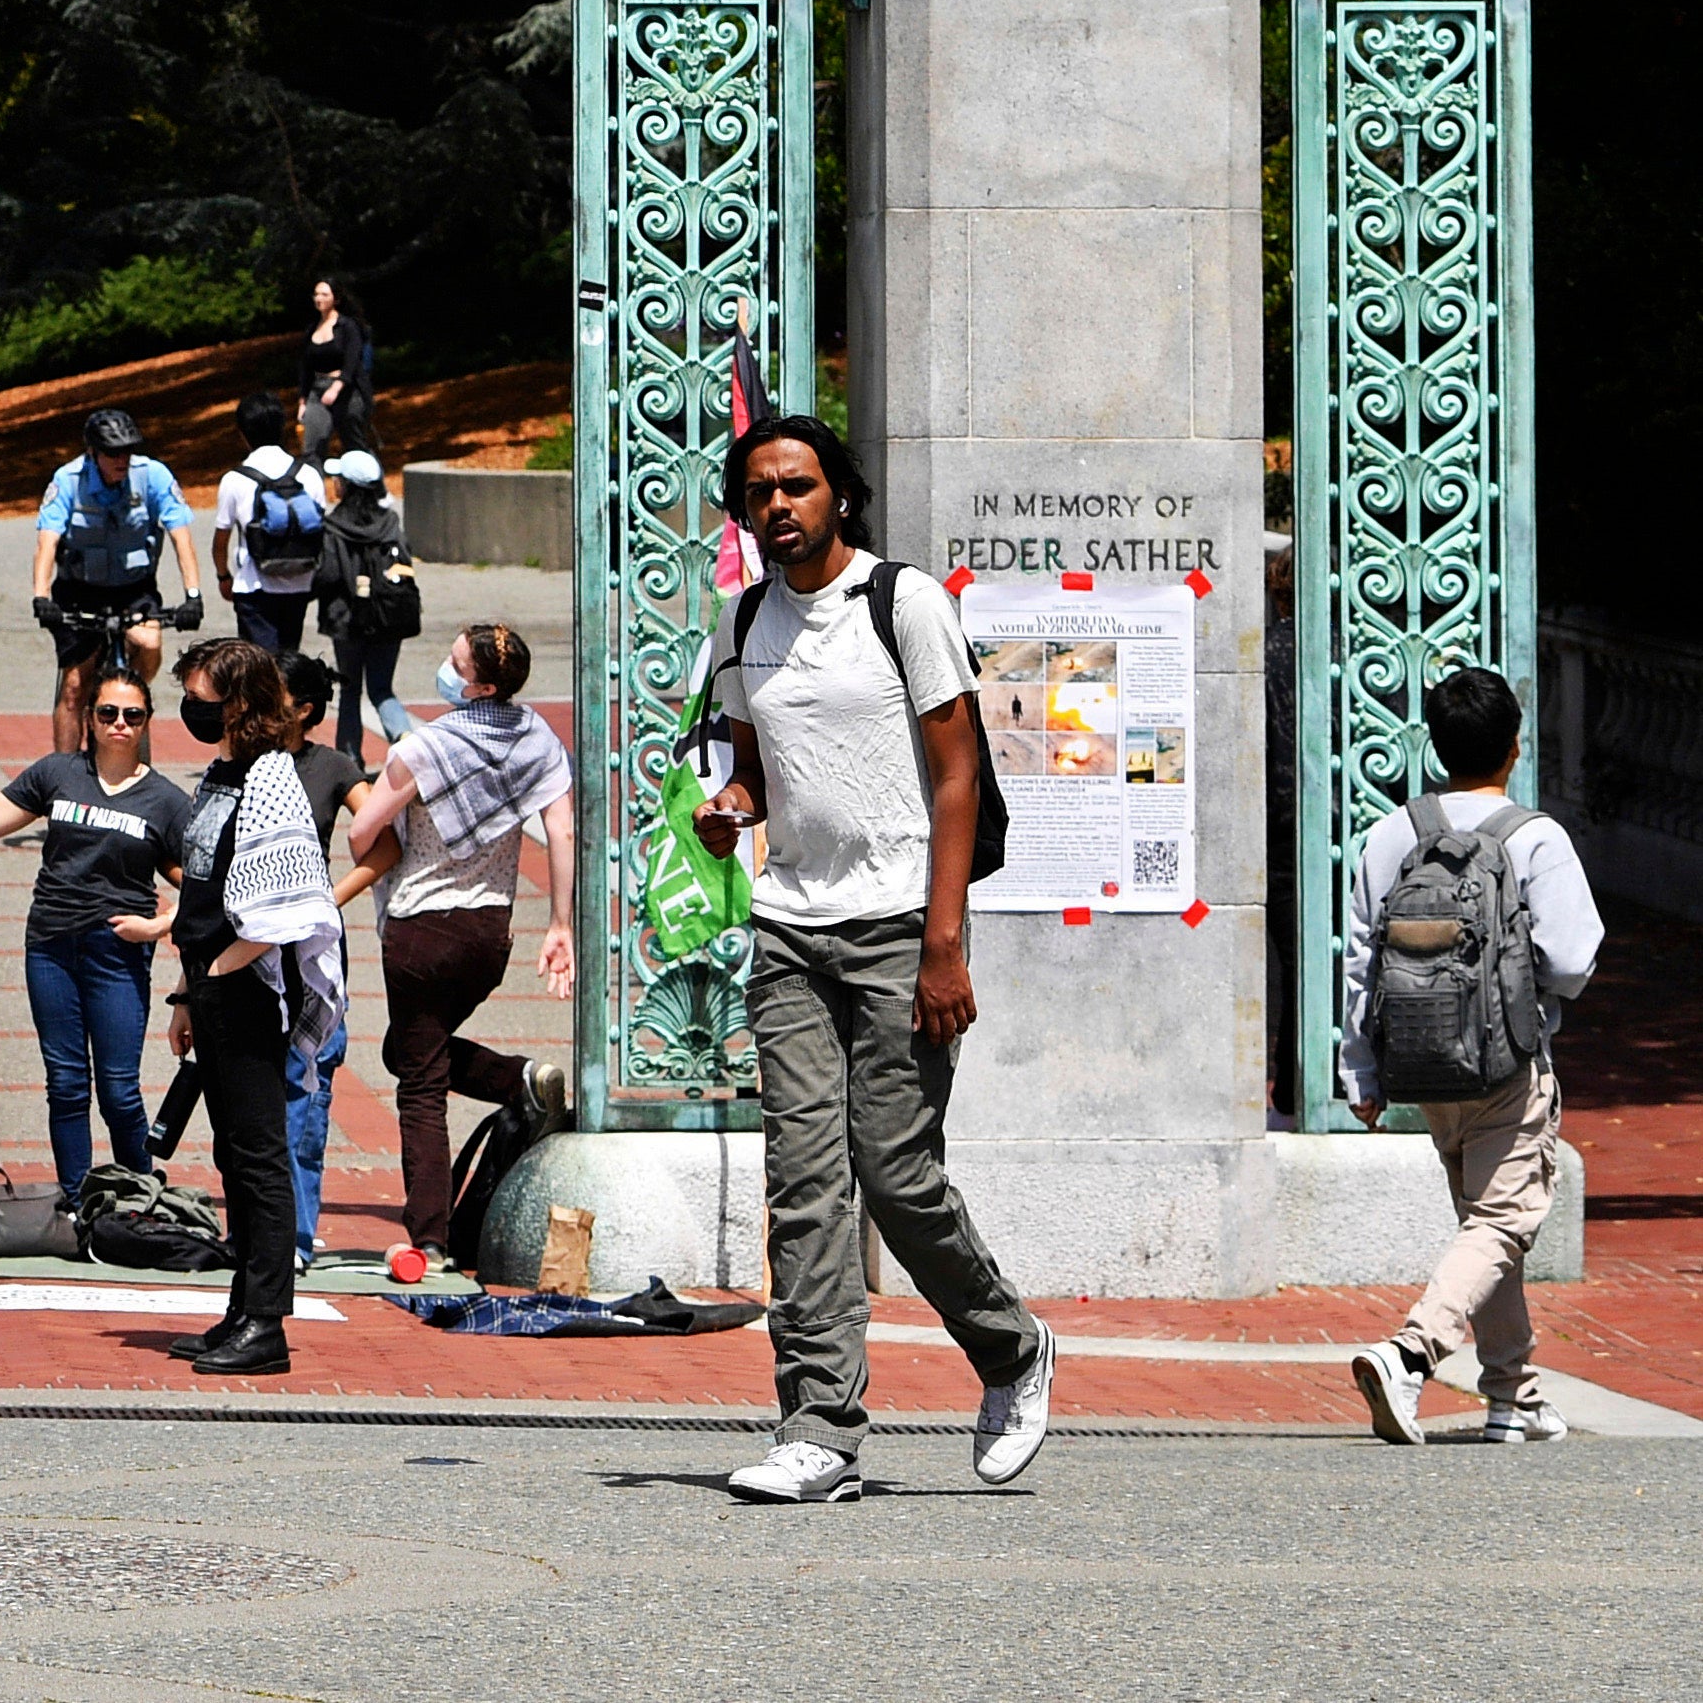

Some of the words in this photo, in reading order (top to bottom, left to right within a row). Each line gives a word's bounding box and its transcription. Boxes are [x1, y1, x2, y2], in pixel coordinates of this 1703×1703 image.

[973, 494, 999, 517] IN
[1014, 494, 1143, 518] MEMORY
[1155, 494, 1194, 517] OF
[947, 537, 1067, 571] PEDER
[1083, 538, 1222, 572] SATHER
